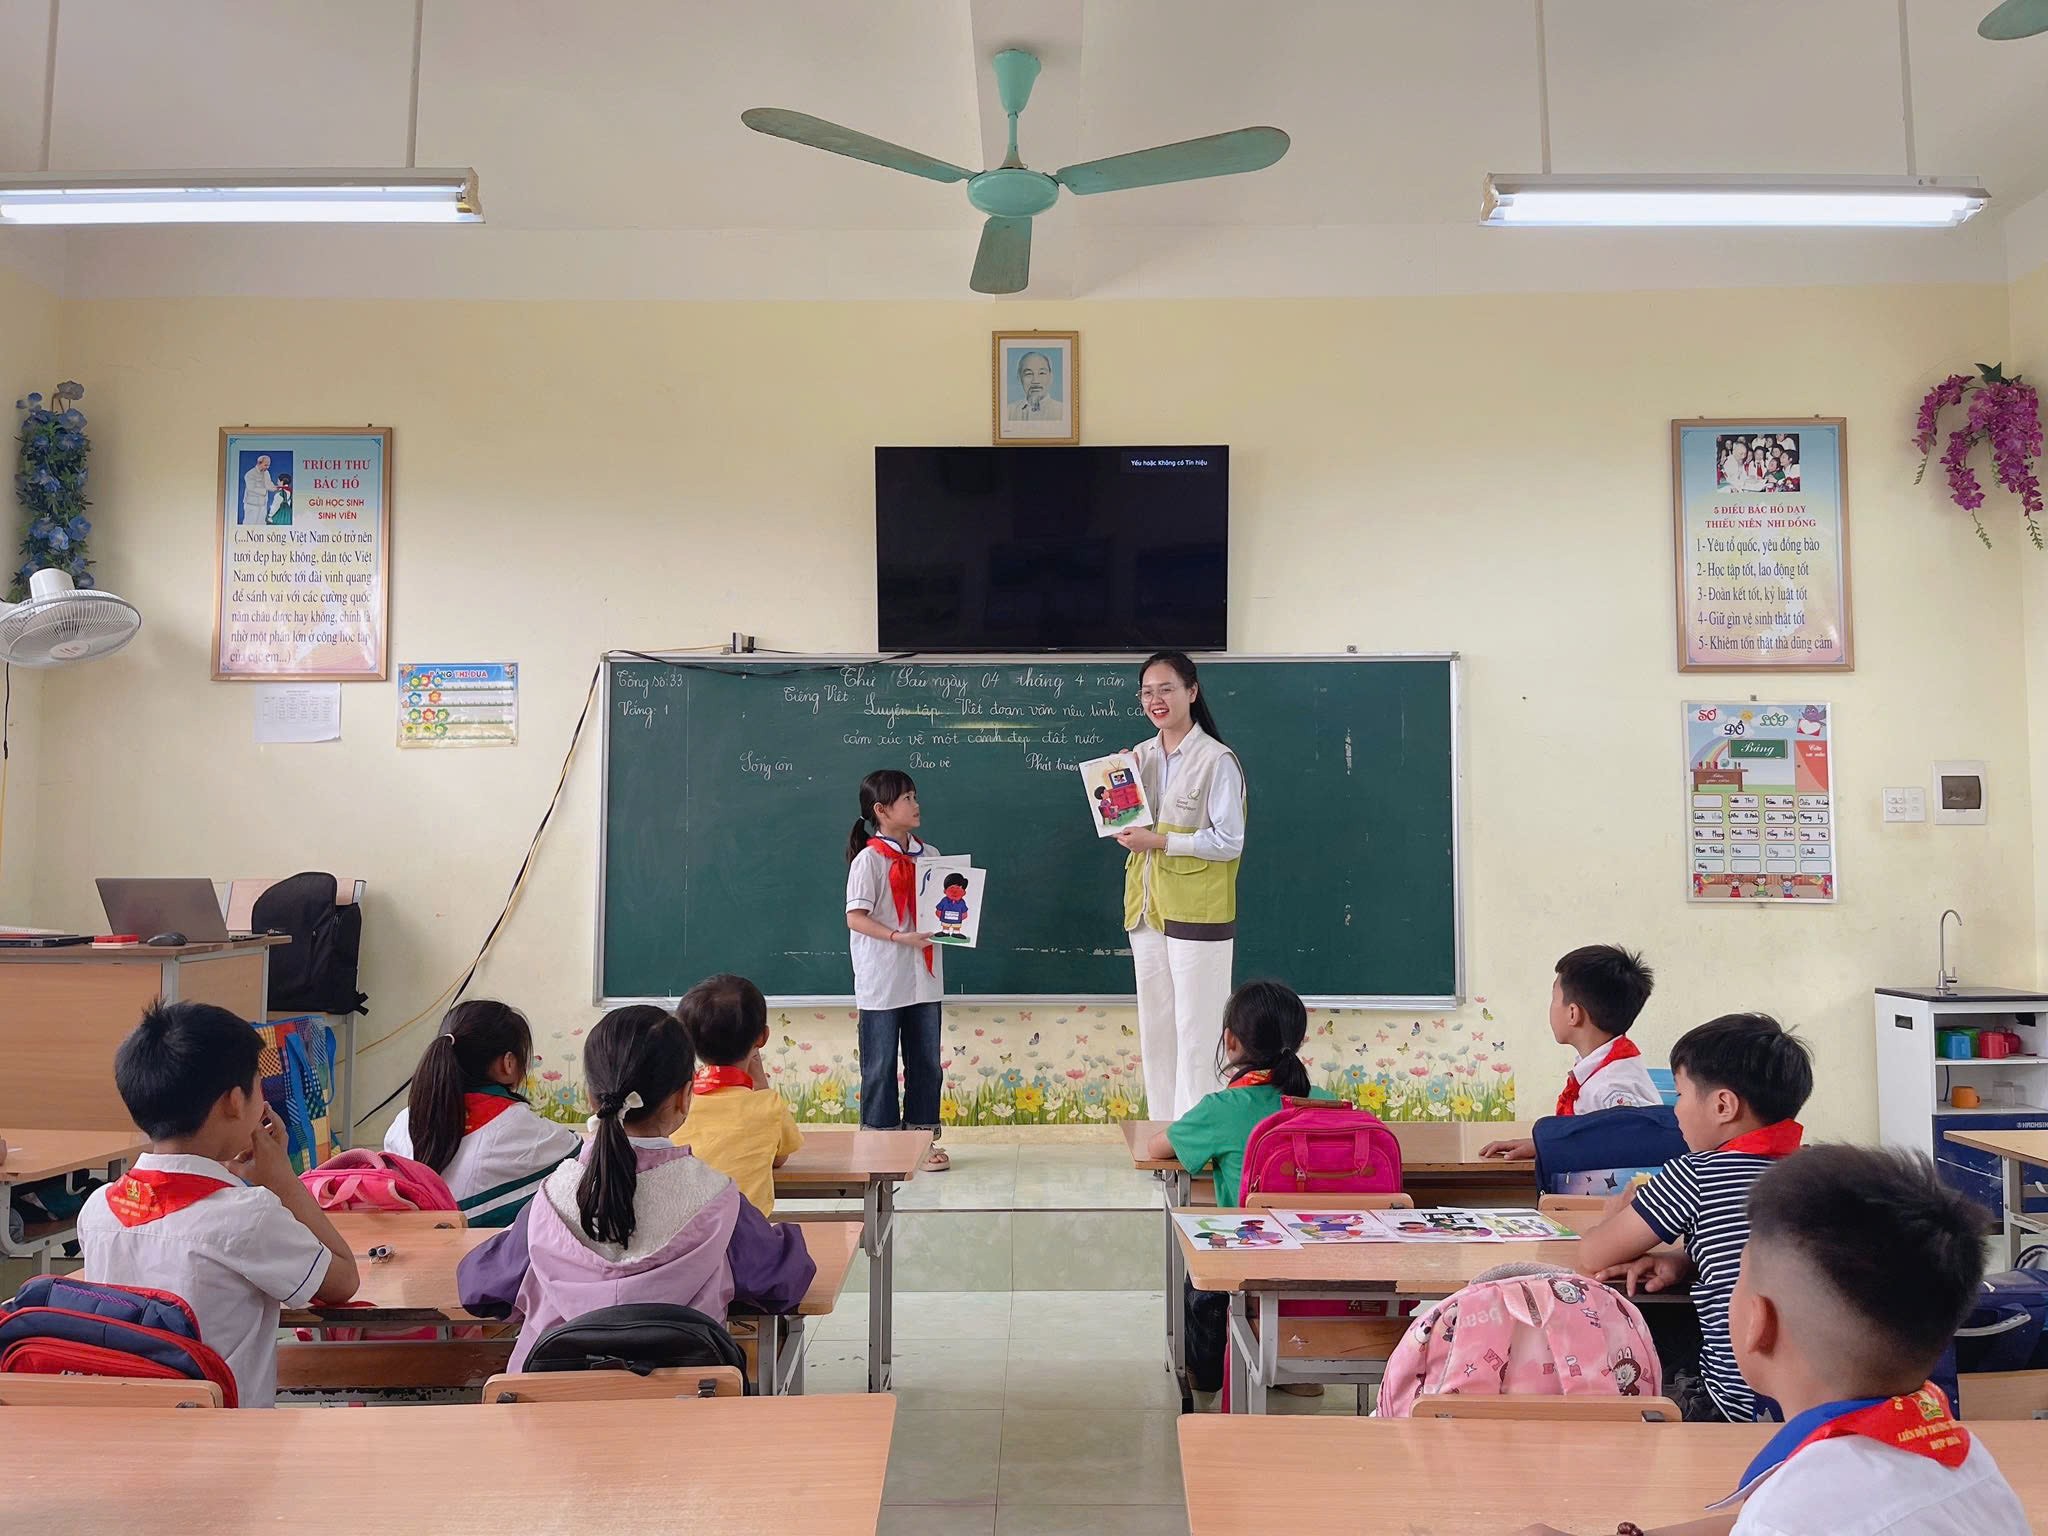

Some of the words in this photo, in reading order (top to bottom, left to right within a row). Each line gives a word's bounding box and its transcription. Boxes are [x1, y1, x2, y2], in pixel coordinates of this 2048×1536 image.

[303, 457, 341, 470] TRÍCH
[345, 459, 371, 470] THƯ
[314, 476, 338, 489] BÁC
[326, 498, 344, 509] HỌC
[346, 499, 365, 507] SINH
[339, 510, 357, 519] VIÊN
[1767, 519, 1785, 528] NHI
[267, 532, 286, 545] sông
[289, 531, 307, 545] Việt
[310, 531, 329, 543] Nam
[332, 531, 342, 543] có
[358, 532, 372, 543] nên
[1707, 538, 1724, 552] Yêu
[1737, 537, 1760, 556] quốc,
[1762, 541, 1778, 556] yêu
[1804, 537, 1820, 552] bào
[234, 550, 251, 562] tươi
[254, 551, 269, 565] đẹp
[272, 551, 288, 566] hay
[290, 551, 319, 566] không,
[321, 550, 336, 562] dân
[339, 551, 352, 566] tộc
[355, 551, 372, 566] Việt
[234, 570, 254, 582] Nam
[258, 571, 268, 582] có
[270, 570, 292, 583] bước
[294, 570, 306, 582] tới
[309, 570, 322, 583] đài
[325, 570, 343, 582] vinh
[346, 573, 372, 586] quang
[1708, 562, 1725, 580] Học
[1727, 563, 1739, 580] tập
[1742, 562, 1756, 578] tốt,
[1758, 562, 1772, 577] lao
[1774, 562, 1795, 580] động
[1797, 561, 1809, 576] tốt
[232, 588, 244, 603] để
[246, 590, 267, 603] sánh
[270, 591, 283, 602] vai
[286, 590, 300, 603] với
[302, 591, 318, 603] các
[1708, 587, 1730, 601] Đoàn
[1733, 586, 1746, 601] kết
[1748, 586, 1762, 602] tốt,
[1778, 587, 1793, 604] luật
[1796, 586, 1808, 601] tốt
[251, 610, 270, 623] châu
[294, 610, 308, 625] hay
[310, 610, 338, 625] không,
[1708, 611, 1725, 625] Giữ
[1727, 612, 1740, 629] gìn
[1743, 612, 1752, 628] vệ
[1755, 611, 1773, 625] sinh
[1775, 611, 1791, 628] thật
[1793, 610, 1805, 625] tốt
[231, 630, 248, 643] nhờ
[292, 630, 306, 643] lớn
[316, 631, 337, 646] công
[339, 630, 354, 645] học
[1710, 635, 1739, 650] Khiêm
[1757, 635, 1773, 653] thật
[1775, 635, 1789, 650] thà
[1791, 636, 1812, 653] dũng
[1814, 634, 1833, 649] cảm
[616, 669, 649, 699] Tổng
[934, 673, 968, 698] ngày
[981, 671, 999, 689] 04
[1016, 667, 1065, 699] tháng
[1074, 673, 1084, 687] 4
[783, 687, 819, 715] Tiếng
[954, 697, 984, 716] Viết
[989, 701, 1024, 719] đoạn
[1028, 703, 1056, 716] văn
[1063, 704, 1085, 718] nêu
[1089, 699, 1120, 717] tình
[1698, 708, 1717, 721] SƠ
[843, 729, 872, 745] cảm
[877, 731, 902, 746] xúc
[931, 732, 960, 747] một
[1041, 726, 1069, 745] đất
[1074, 728, 1104, 744] nước
